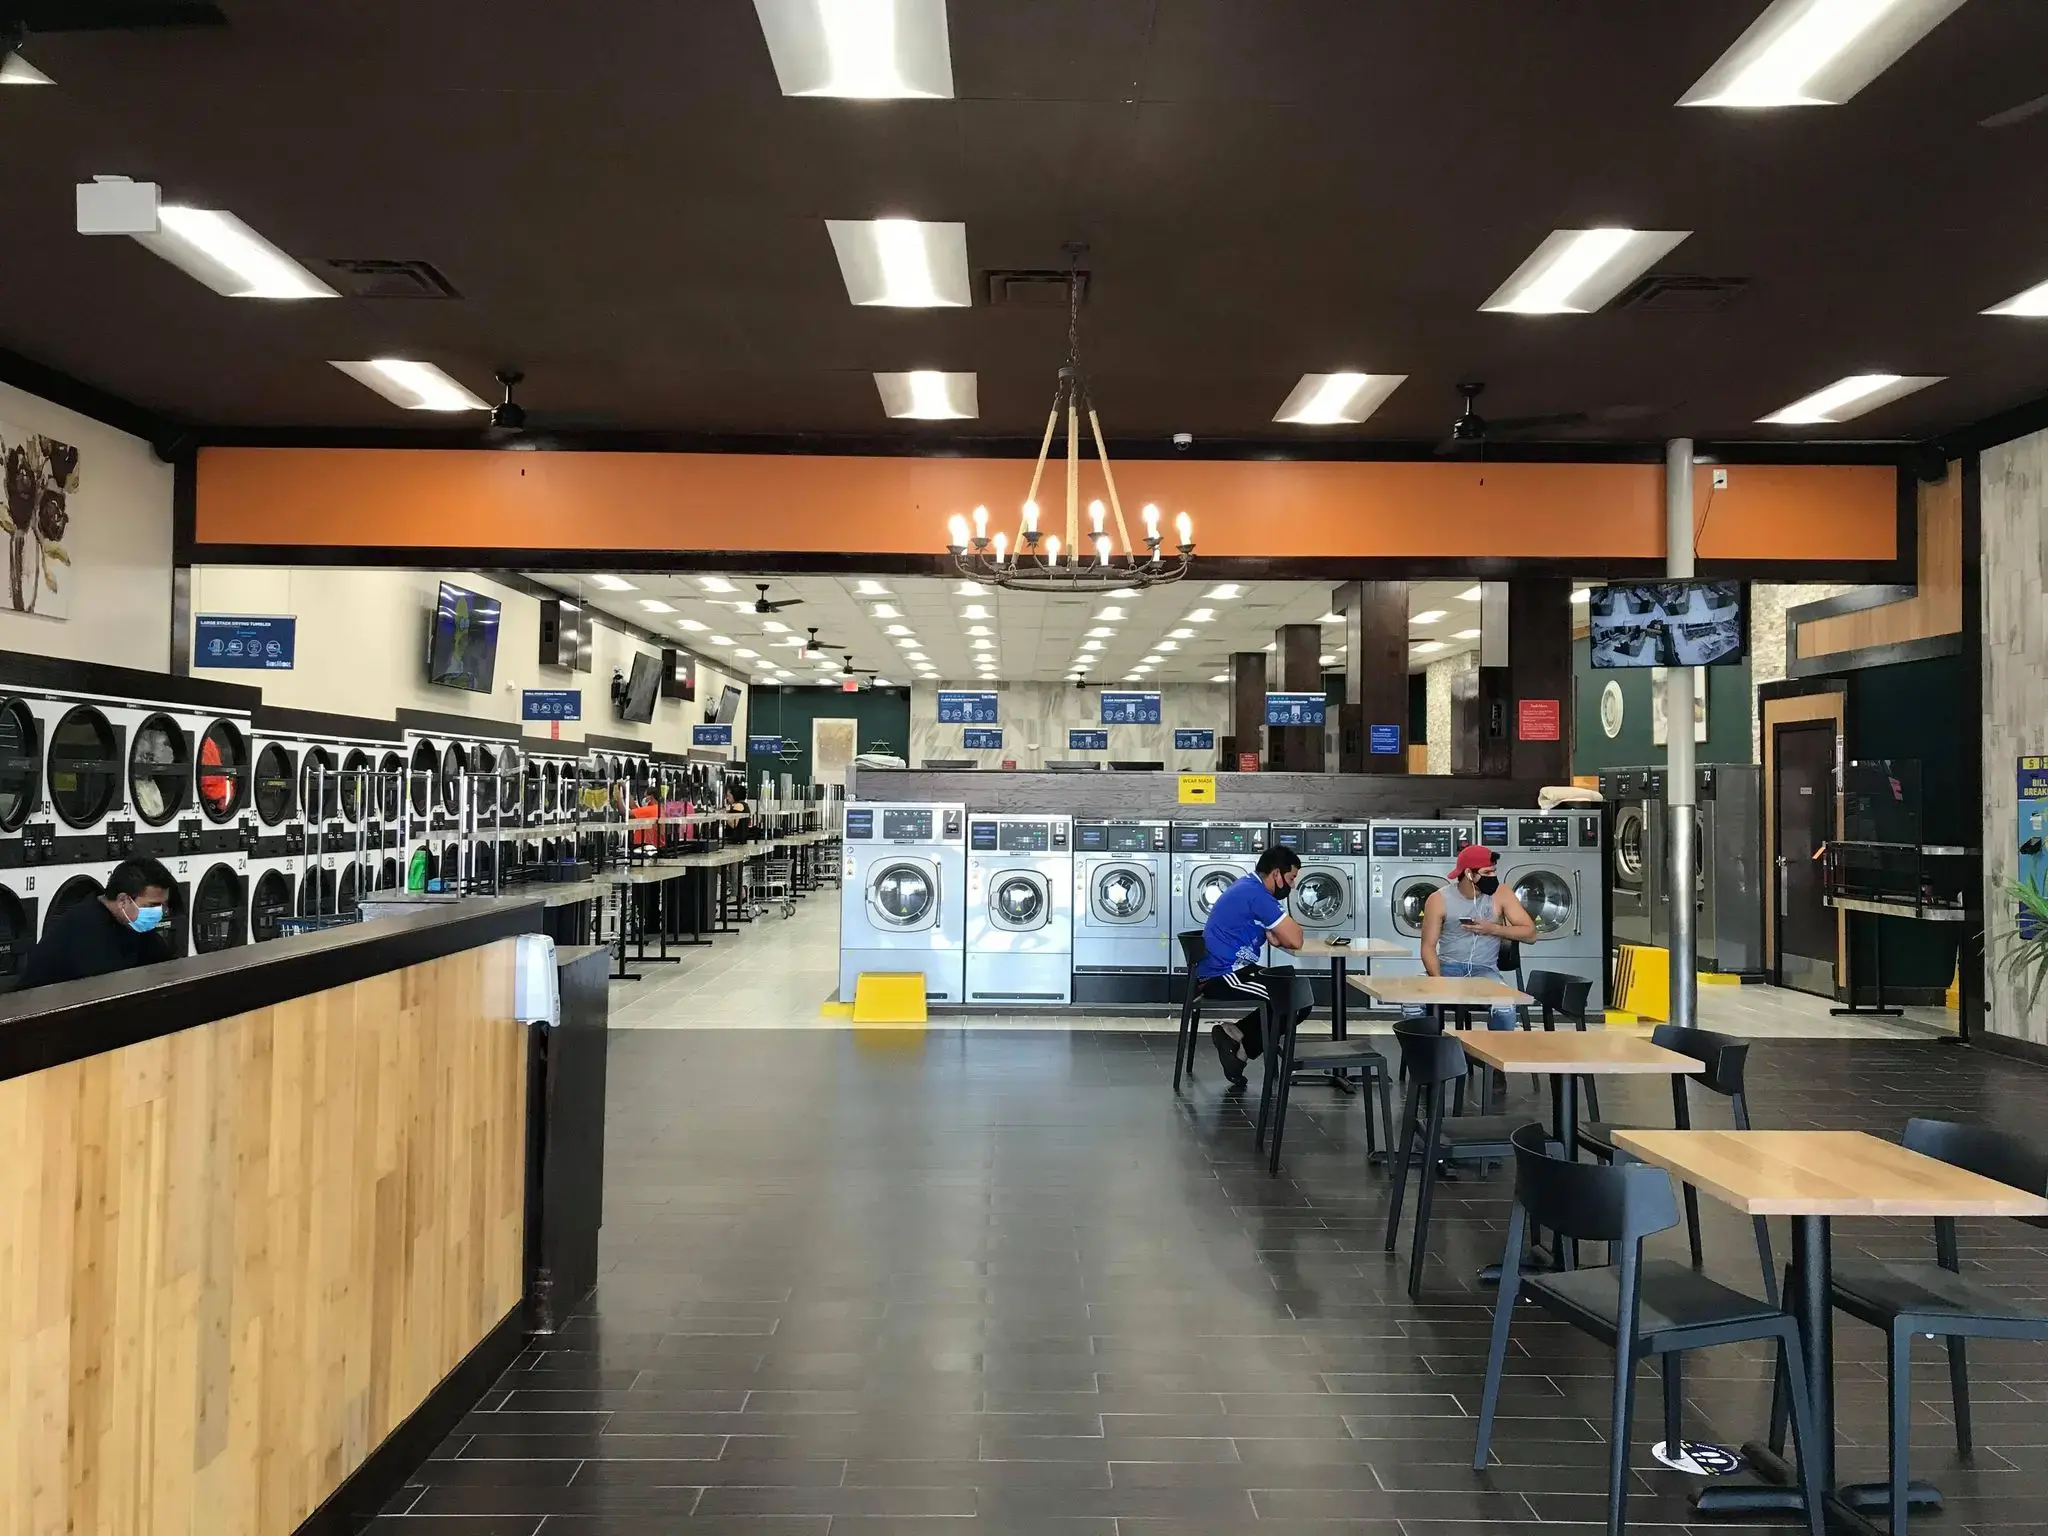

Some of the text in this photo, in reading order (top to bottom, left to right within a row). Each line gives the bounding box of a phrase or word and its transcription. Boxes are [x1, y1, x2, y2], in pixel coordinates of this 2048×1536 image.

[2032, 778, 2048, 787] BILL
[2023, 787, 2048, 796] BREAK
[124, 802, 132, 815] 21
[948, 810, 957, 823] 7
[1055, 822, 1065, 835] 6
[1586, 817, 1592, 831] 1
[1154, 827, 1163, 840] 5
[1253, 829, 1262, 842] 4
[1352, 830, 1361, 844] 3
[1458, 828, 1467, 841] 2
[178, 860, 187, 873] 22
[238, 858, 246, 869] 24
[25, 875, 35, 891] 18
